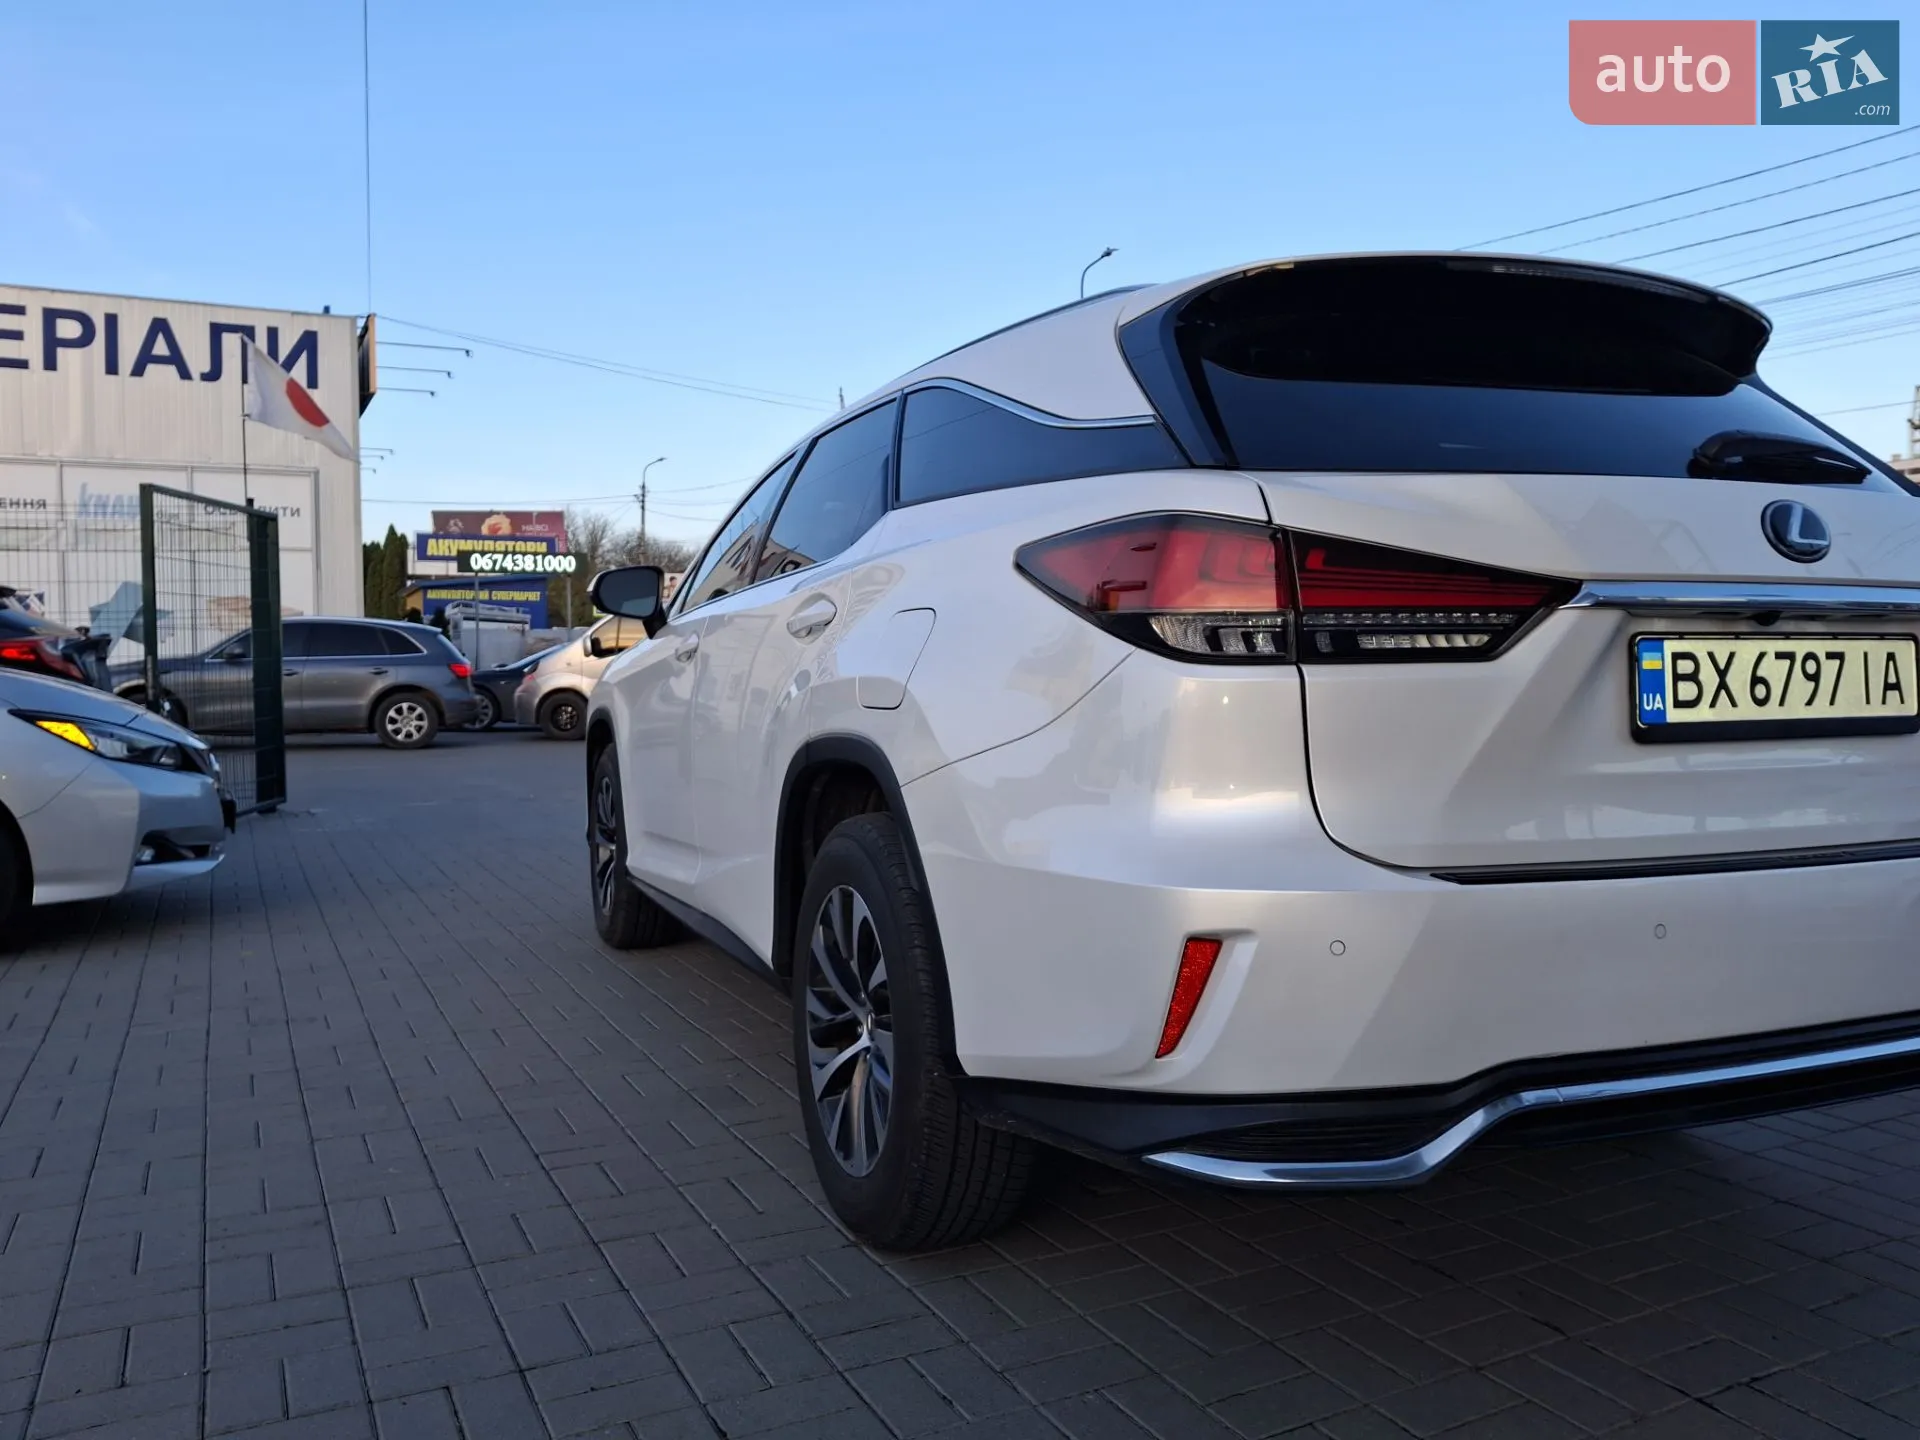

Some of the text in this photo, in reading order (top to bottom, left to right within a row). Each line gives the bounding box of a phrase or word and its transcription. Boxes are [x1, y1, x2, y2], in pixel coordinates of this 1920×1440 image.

[470, 553, 576, 572] 0674381000
[1671, 651, 1905, 709] BX 6797 IA
[1643, 693, 1664, 711] UA
